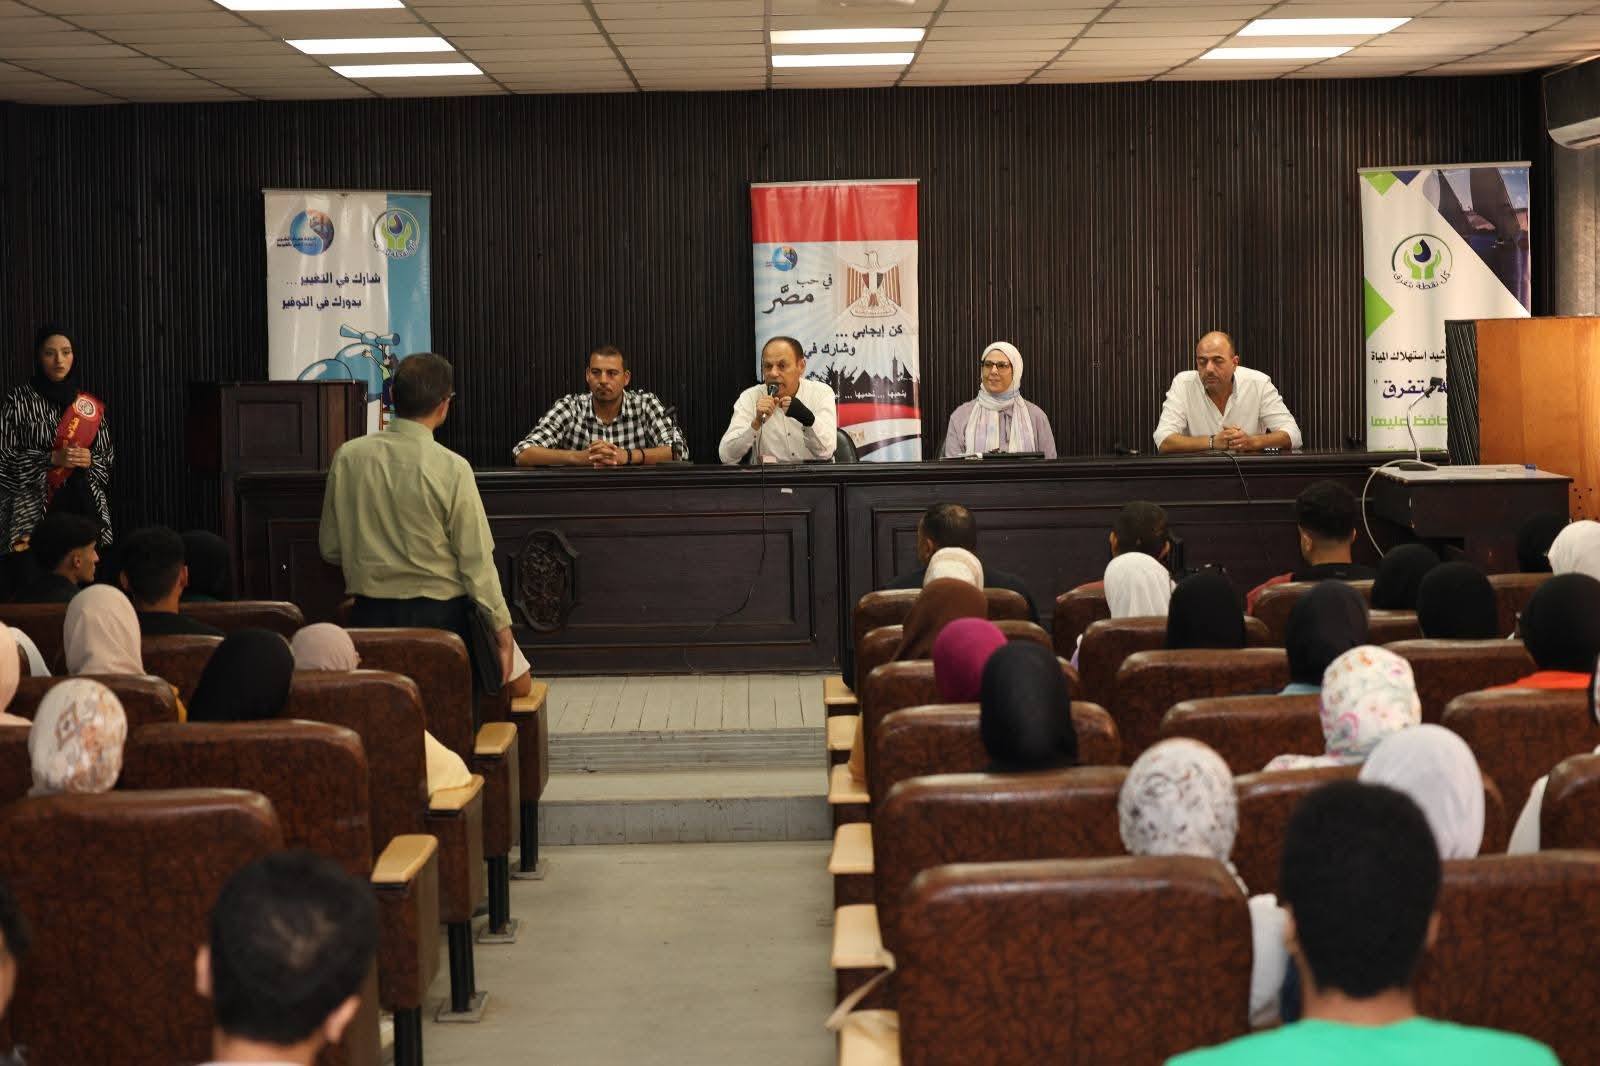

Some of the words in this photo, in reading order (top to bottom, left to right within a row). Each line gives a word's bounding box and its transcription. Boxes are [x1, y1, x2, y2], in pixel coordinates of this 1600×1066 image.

[300, 272, 333, 286] التغيير
[336, 275, 350, 288] في
[351, 273, 381, 287] شارك
[796, 279, 820, 287] حب
[822, 274, 833, 290] في
[1440, 270, 1451, 285] كل
[1415, 280, 1440, 290] نقطة
[282, 296, 313, 310] التوفير
[316, 297, 330, 311] في
[332, 297, 362, 308] بدورك
[852, 325, 885, 340] إيجابي
[888, 324, 903, 337] كن
[804, 342, 818, 359] في
[821, 343, 856, 356] وشارك
[1389, 350, 1427, 362] استهلاك
[1429, 350, 1446, 362] شيد
[1382, 380, 1425, 399] تفرق
